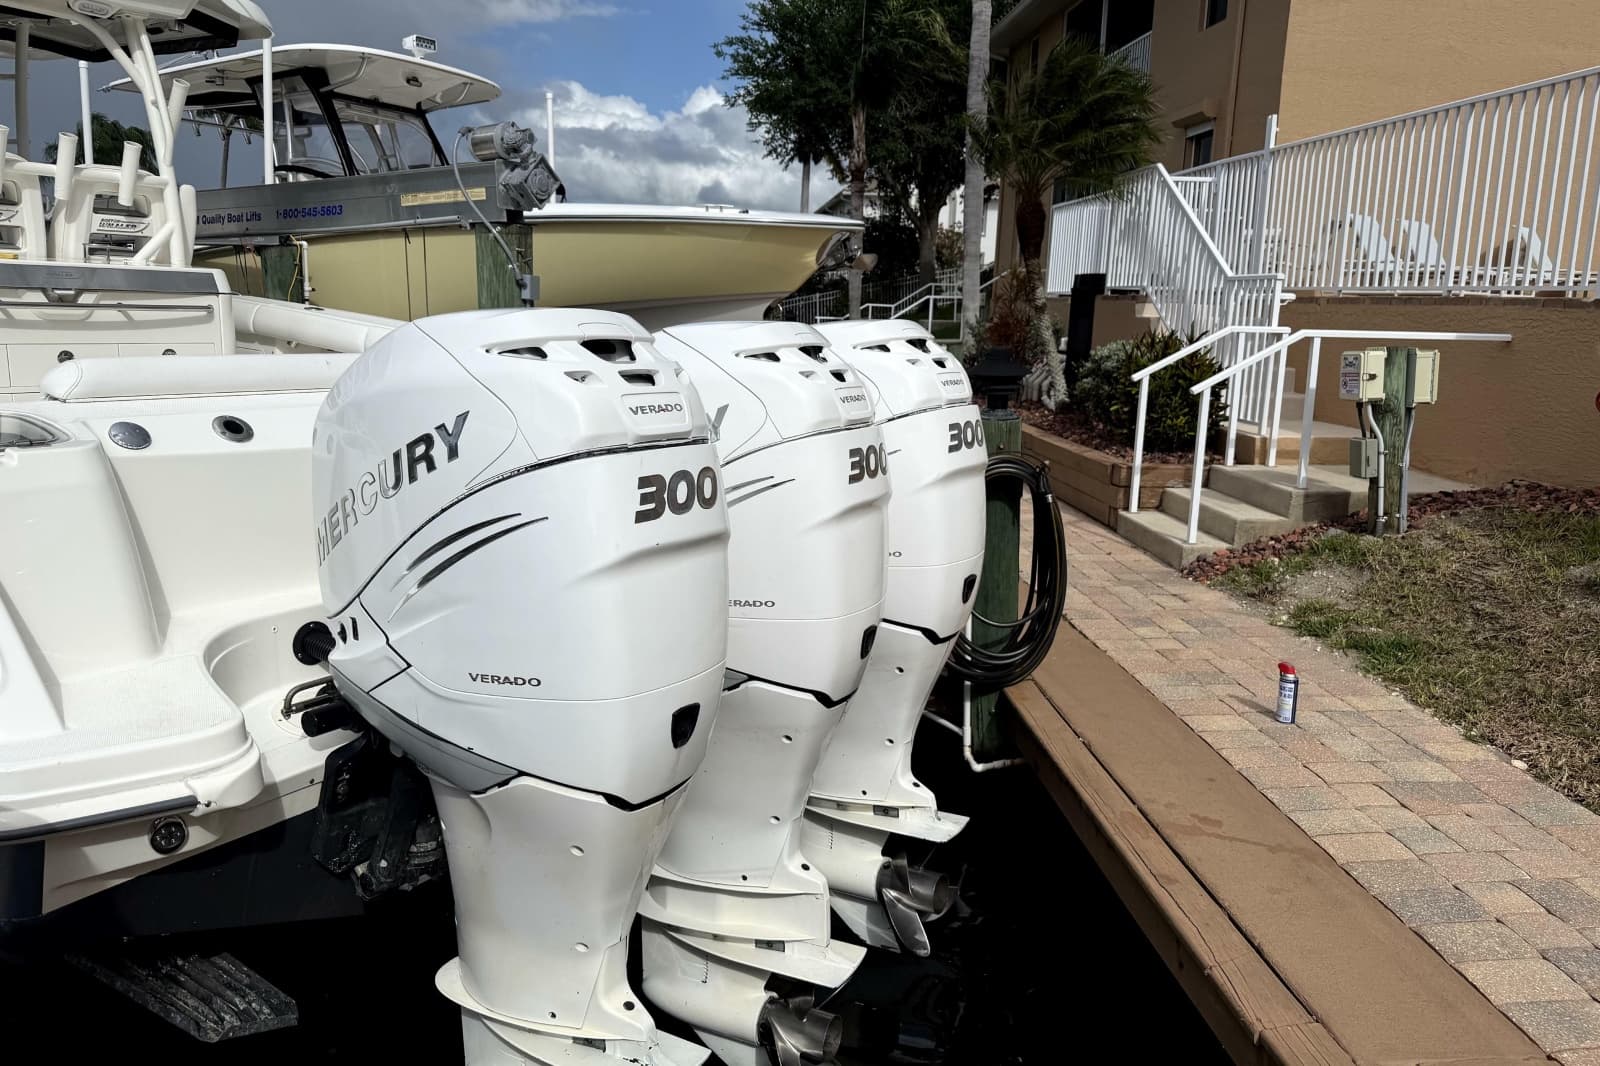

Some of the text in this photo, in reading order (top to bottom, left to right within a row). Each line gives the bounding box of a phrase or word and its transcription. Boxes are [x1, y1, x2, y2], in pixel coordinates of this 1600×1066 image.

[201, 213, 225, 226] Quality
[227, 213, 244, 223] Boat
[245, 211, 262, 222] Lifts
[276, 204, 343, 220] 1-800-545-5603
[941, 379, 964, 388] VERADO
[628, 402, 684, 416] VERADO
[839, 393, 867, 404] VERADO
[948, 418, 984, 454] 300
[848, 442, 888, 485] 300
[317, 410, 471, 568] MERCURY
[634, 465, 719, 525] 300
[468, 672, 542, 687] VERADO
